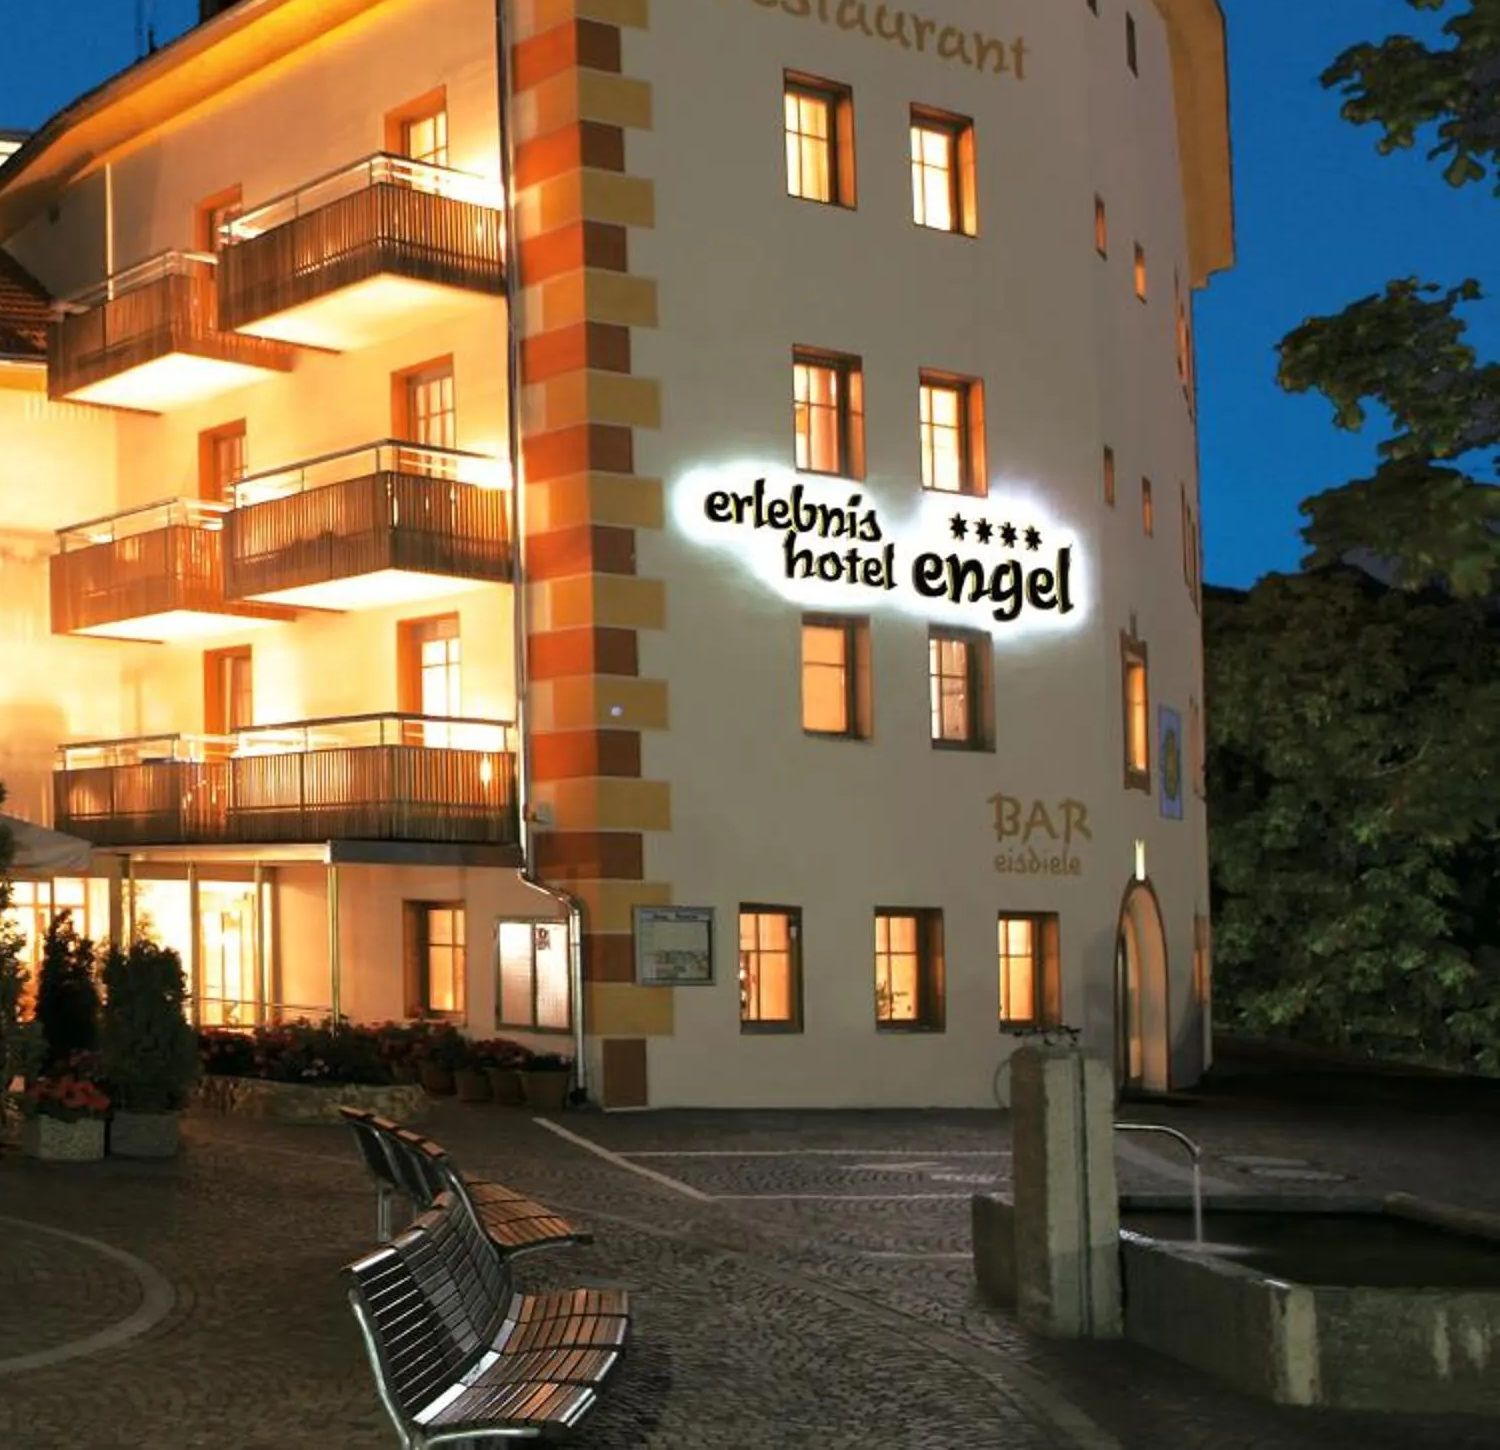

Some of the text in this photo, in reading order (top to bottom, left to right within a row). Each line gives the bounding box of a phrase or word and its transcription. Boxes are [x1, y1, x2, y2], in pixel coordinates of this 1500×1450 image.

[705, 479, 882, 541] erlebnis
[784, 531, 897, 589] hotel
[912, 544, 1074, 621] engel
[987, 792, 1092, 843] BAR
[994, 846, 1081, 874] eisdiele
